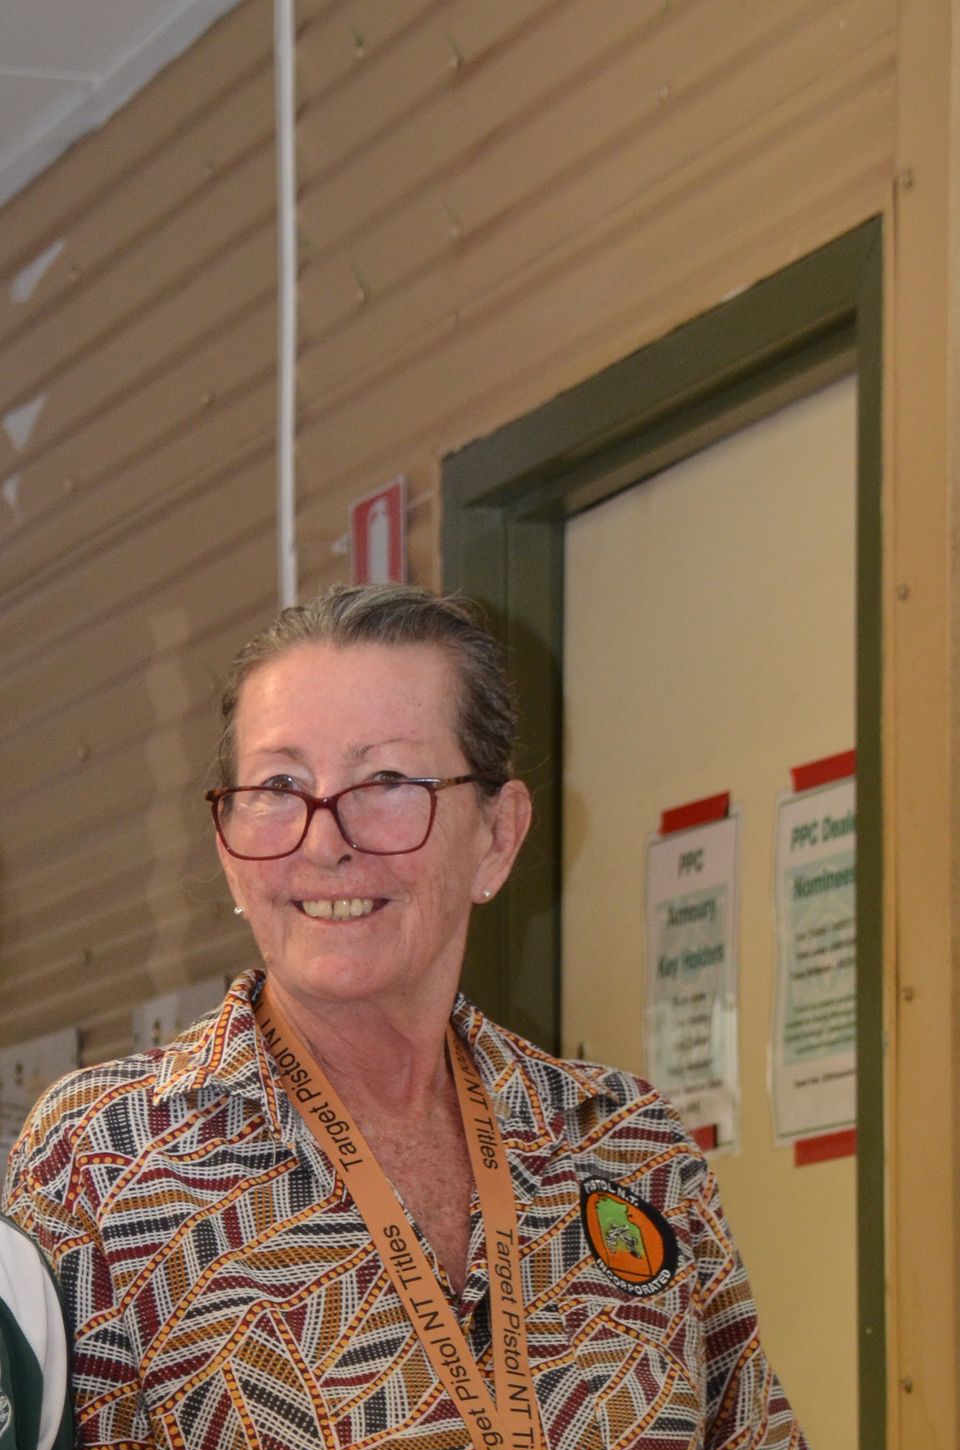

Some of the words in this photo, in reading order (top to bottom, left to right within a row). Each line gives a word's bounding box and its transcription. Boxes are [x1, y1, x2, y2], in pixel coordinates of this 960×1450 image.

[791, 820, 819, 851] PPC
[679, 848, 705, 877] PPC
[667, 897, 716, 928] Armoury
[657, 957, 679, 981] Key
[681, 944, 725, 973] Holders
[274, 1047, 322, 1103] Pistol
[463, 1077, 489, 1111] NT
[309, 1102, 363, 1172] Target
[474, 1117, 499, 1170] Titles
[583, 1179, 616, 1194] PISTOL
[383, 1224, 423, 1290] Titles
[494, 1229, 514, 1309] Target
[596, 1258, 671, 1295] INCORPORATED
[410, 1297, 445, 1331] NT
[501, 1309, 526, 1377] Pistol
[430, 1336, 479, 1402] Pistol
[507, 1383, 533, 1420] NT
